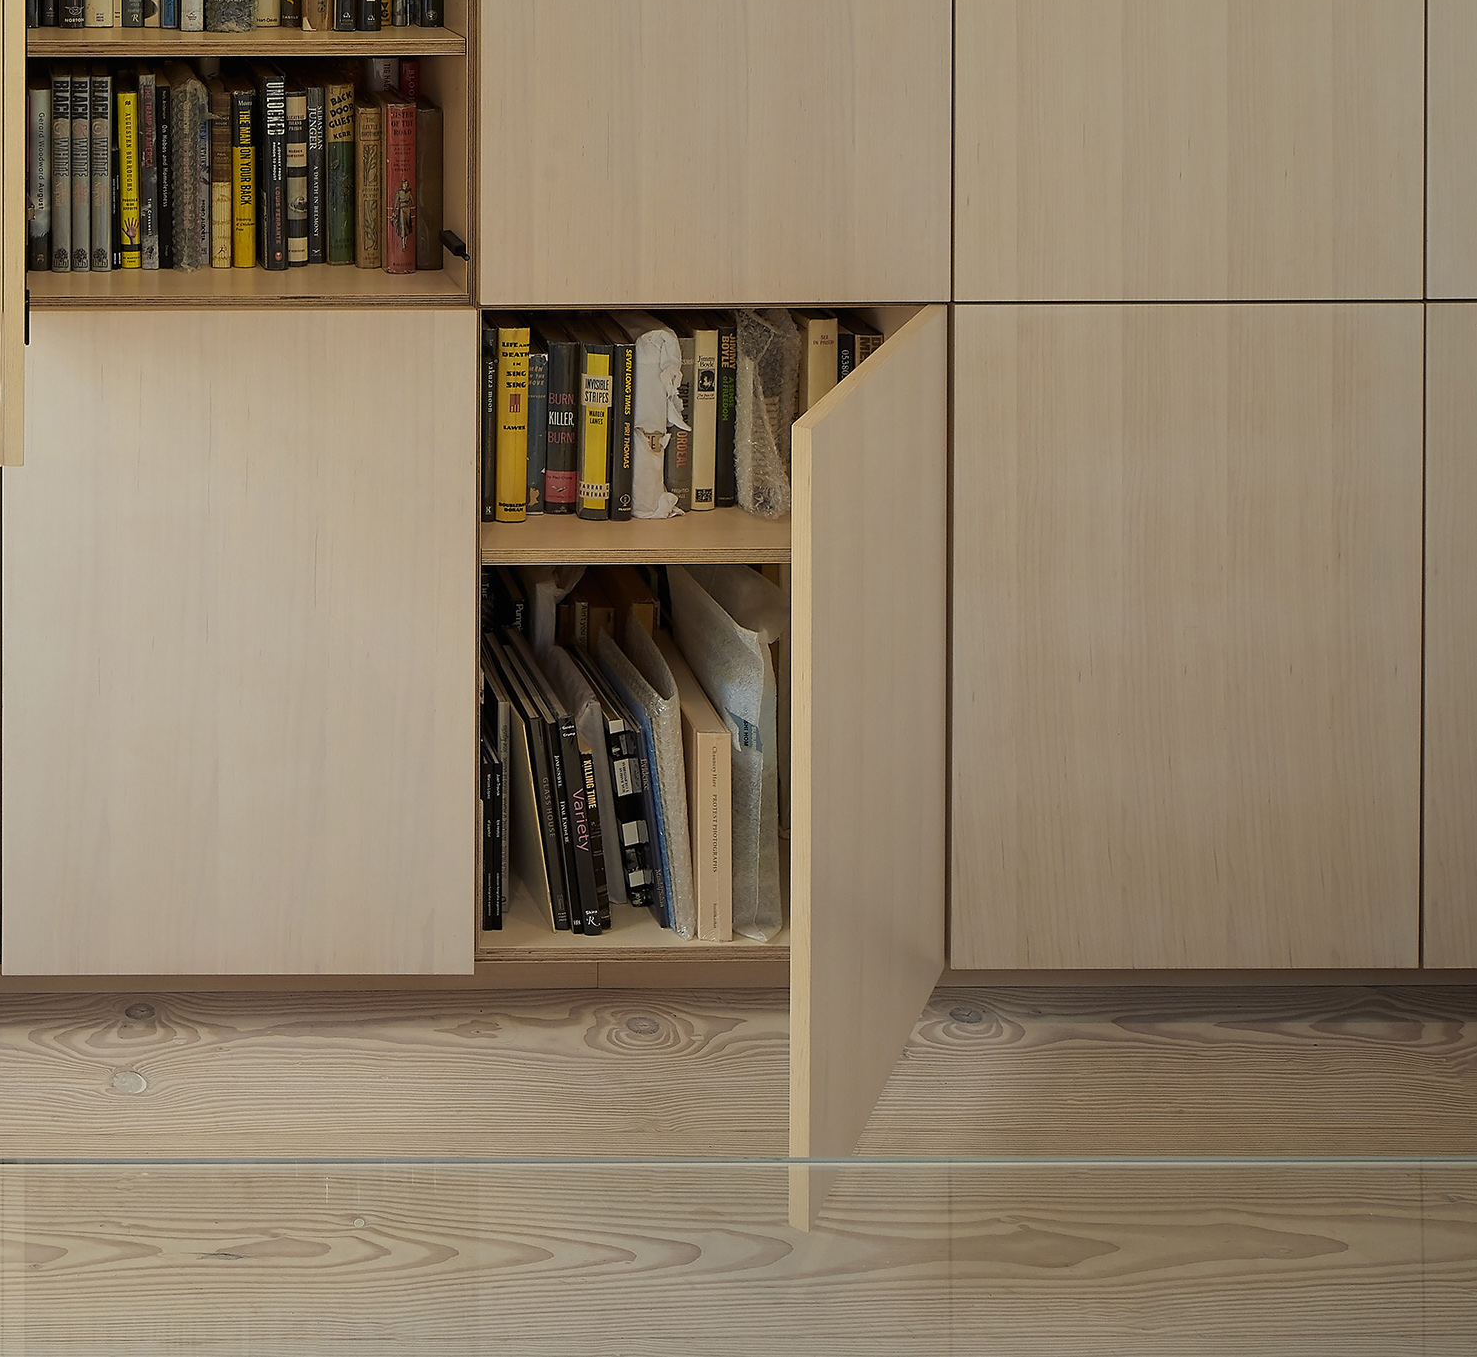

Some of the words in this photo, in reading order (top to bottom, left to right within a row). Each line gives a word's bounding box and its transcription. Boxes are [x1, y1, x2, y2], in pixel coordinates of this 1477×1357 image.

[239, 110, 252, 125] THE
[266, 82, 285, 136] UNLOCKED
[38, 112, 46, 138] Gerard
[239, 127, 252, 146] MAN
[38, 140, 46, 180] Woodward
[239, 148, 252, 160] ON
[239, 162, 252, 182] YOUR
[36, 182, 46, 210] August
[239, 184, 252, 205] BACK
[624, 348, 632, 373] SEVEN
[624, 373, 632, 394] LONG
[584, 392, 610, 403] STRIPES
[624, 394, 632, 415] TIMES
[622, 422, 630, 436] PIRI
[622, 436, 630, 469] THOMAS
[582, 760, 594, 788] KILLING
[586, 789, 596, 810] TIME
[572, 788, 590, 852] Variety
